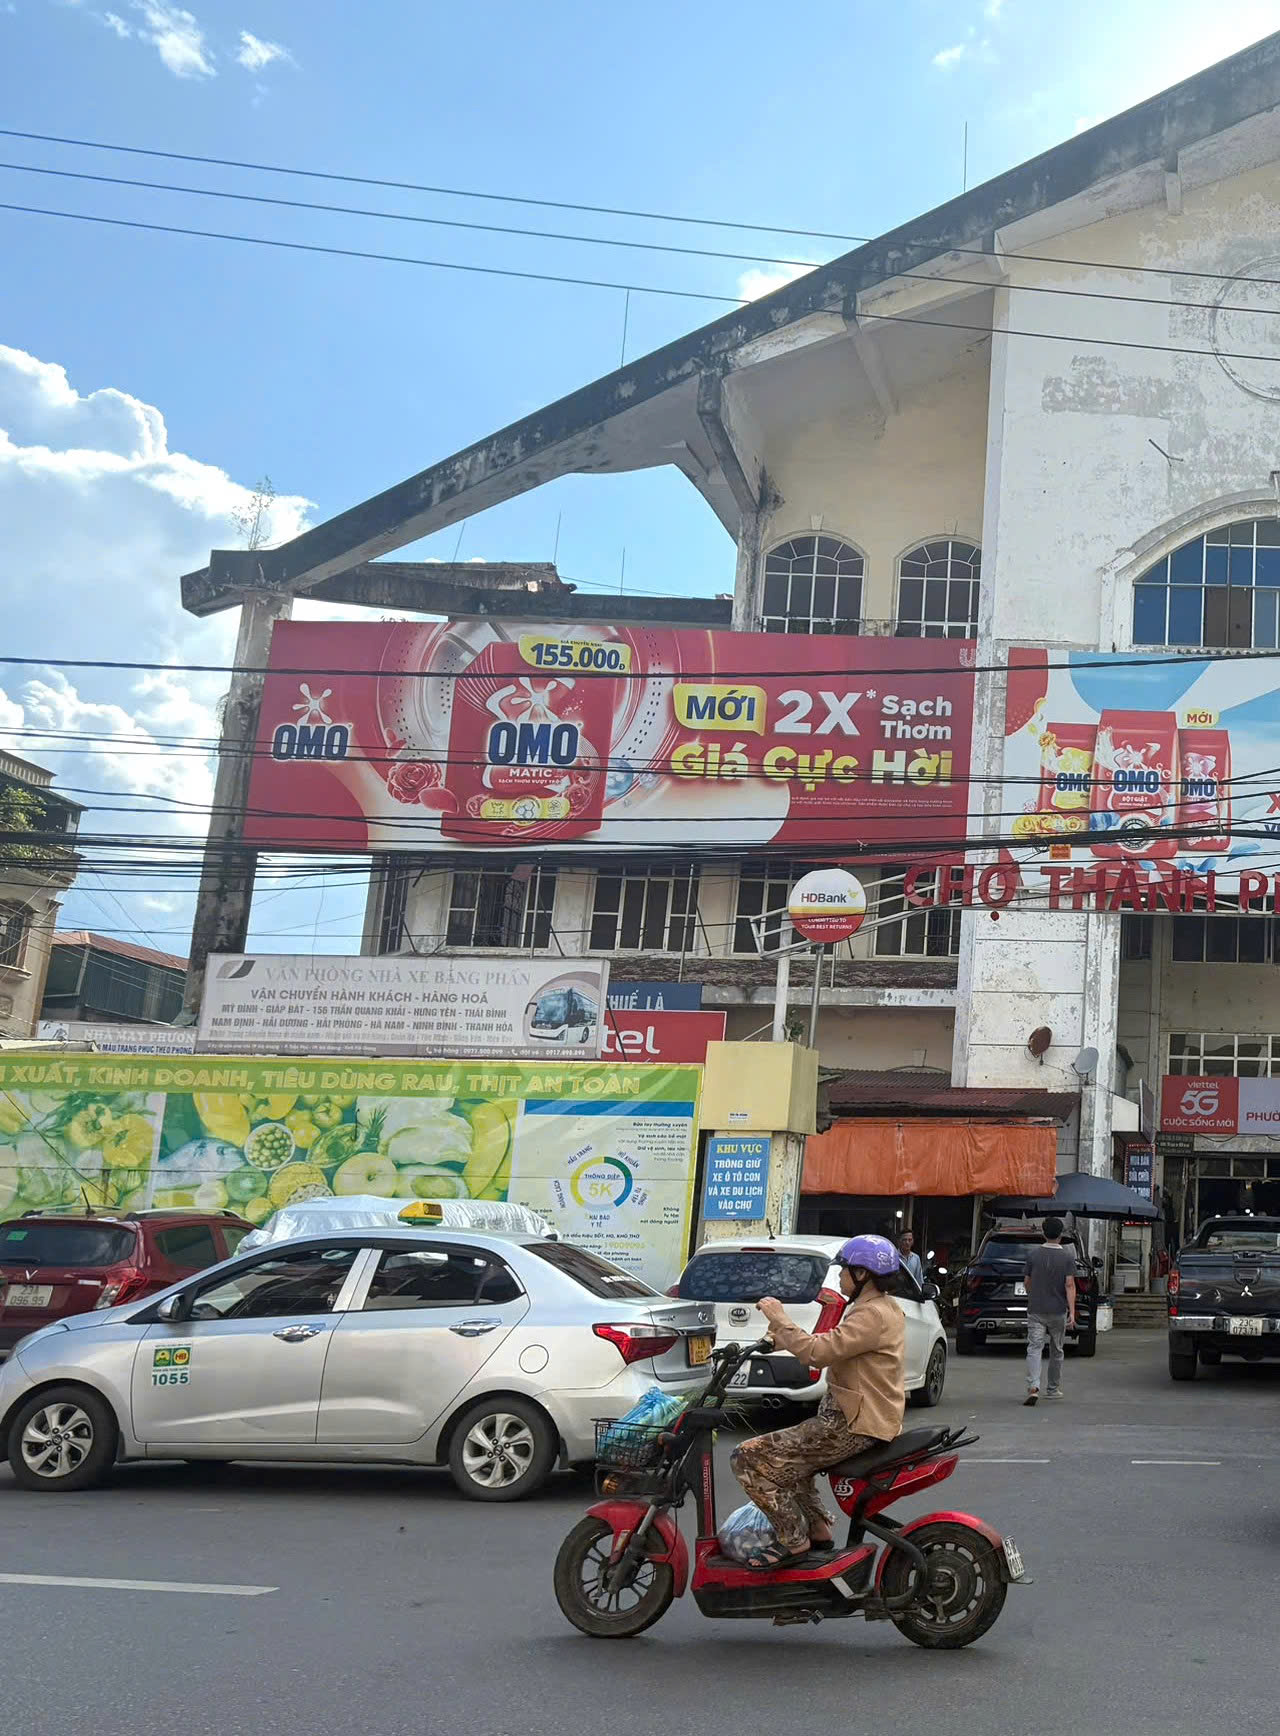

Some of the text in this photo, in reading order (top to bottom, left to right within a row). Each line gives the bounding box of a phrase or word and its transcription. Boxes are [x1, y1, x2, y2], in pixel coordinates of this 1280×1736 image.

[686, 690, 755, 721] MỚI
[881, 694, 952, 720] Sạch
[1187, 711, 1212, 723] MỚI
[881, 721, 951, 740] Thơm
[273, 725, 349, 760] OMO
[489, 723, 579, 764] OMO
[510, 768, 552, 777] MATIC
[670, 741, 952, 791] Giá Cực Hời
[1114, 770, 1159, 793] OMO
[1041, 858, 1216, 914] THÀNH
[801, 893, 846, 903] HDBank
[370, 967, 401, 983] NHÀ
[408, 971, 428, 984] XE
[251, 985, 488, 1003] VẬN CHUYỂN HÀNH KHÁCH HÀNG HOÁ
[313, 1006, 327, 1014] 156
[355, 1006, 382, 1015] QUANG
[89, 1066, 148, 1086] KINH
[154, 1068, 254, 1090] DOANH,
[262, 1068, 314, 1088] TIÊU
[320, 1068, 395, 1090] DÙNG
[401, 1073, 460, 1093] RAU,
[467, 1074, 521, 1096] THỊT
[527, 1075, 562, 1093] AN
[571, 1073, 640, 1094] TOÀN
[1188, 1081, 1218, 1089] viettel
[1181, 1090, 1218, 1115] 5G
[1164, 1116, 1234, 1128] CUỘC SỐNG MỚI
[717, 1144, 762, 1155] KHU VỰC
[715, 1159, 743, 1168] TRÔNG
[713, 1173, 723, 1181] XE
[733, 1172, 742, 1181] TÔ
[744, 1173, 760, 1181] CON
[589, 1183, 613, 1196] 5K
[708, 1186, 762, 1197] VÀ XE DU LỊCH
[718, 1199, 752, 1211] VÀO CHỢ
[152, 1373, 188, 1385] 1055
